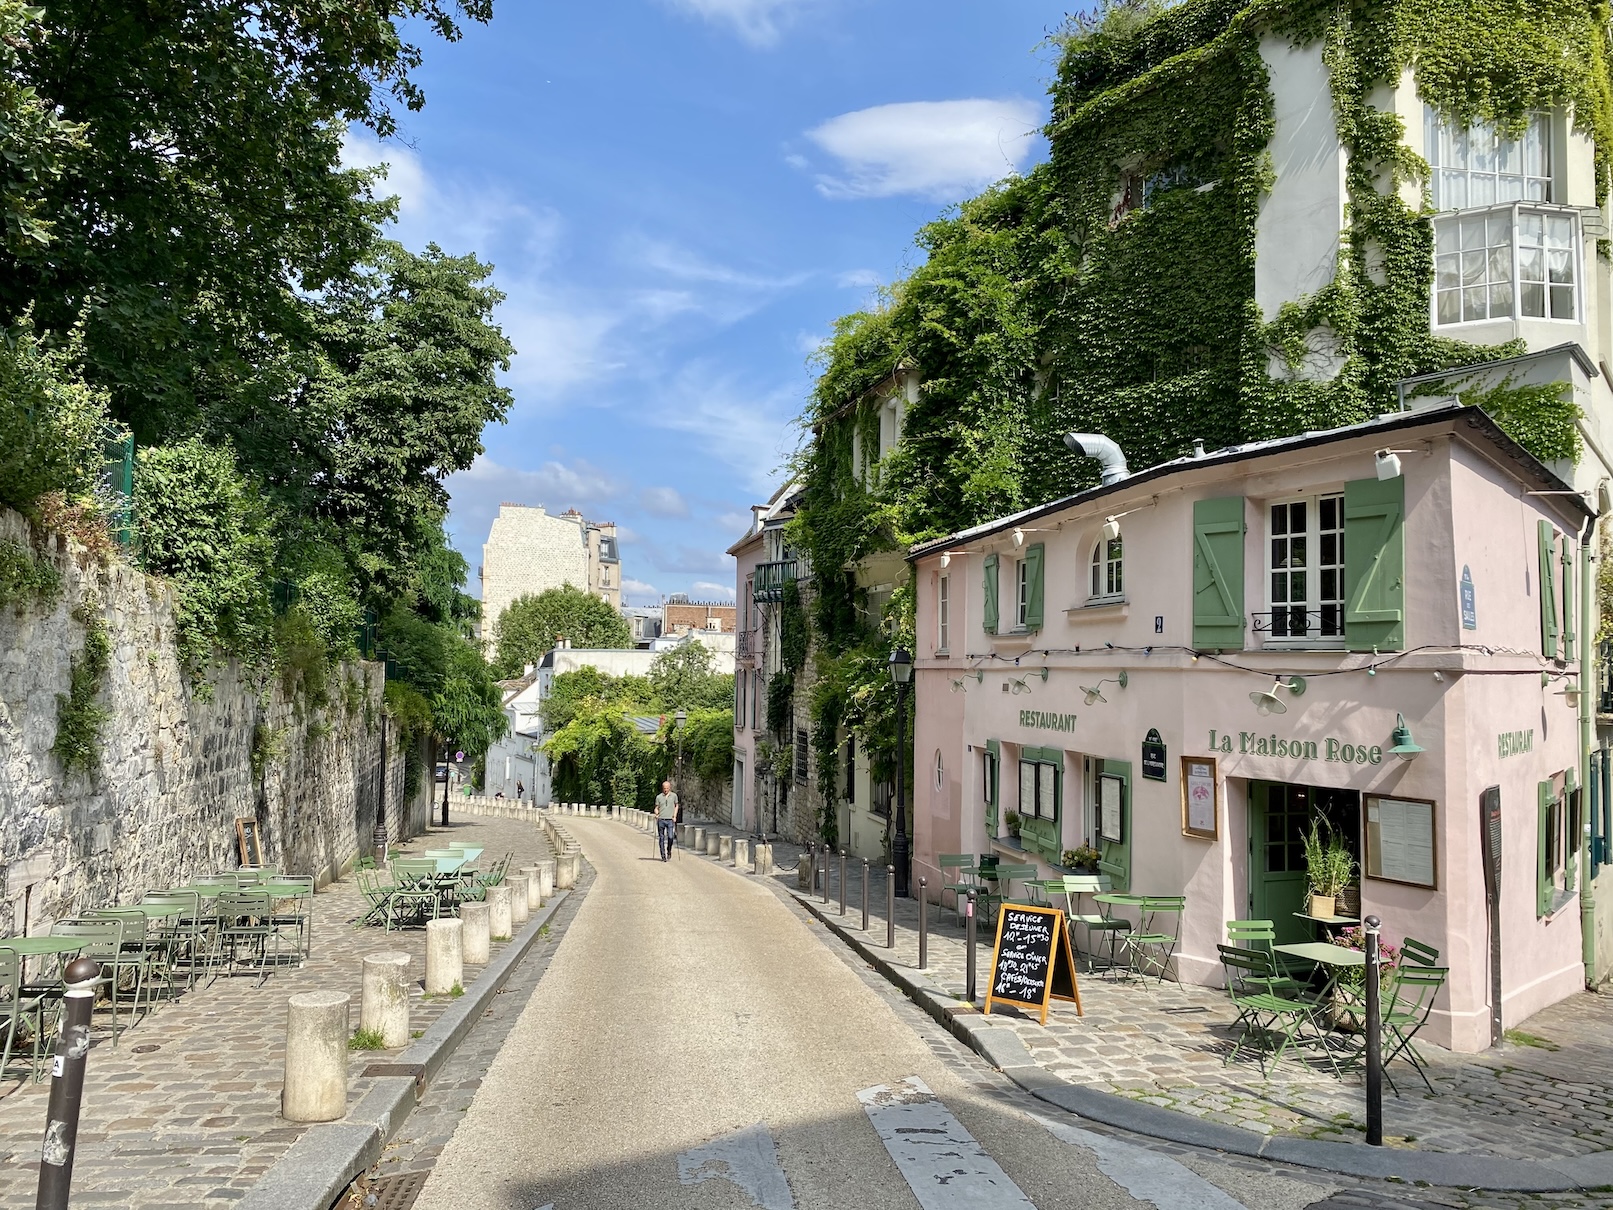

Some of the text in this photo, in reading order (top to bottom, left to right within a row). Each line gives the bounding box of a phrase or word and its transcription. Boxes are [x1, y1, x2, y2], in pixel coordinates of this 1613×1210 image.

[1156, 617, 1162, 633] 2
[1019, 709, 1077, 733] RESTAURANT
[1208, 729, 1383, 765] La Maison Rose
[1498, 729, 1534, 759] RESTAURANT
